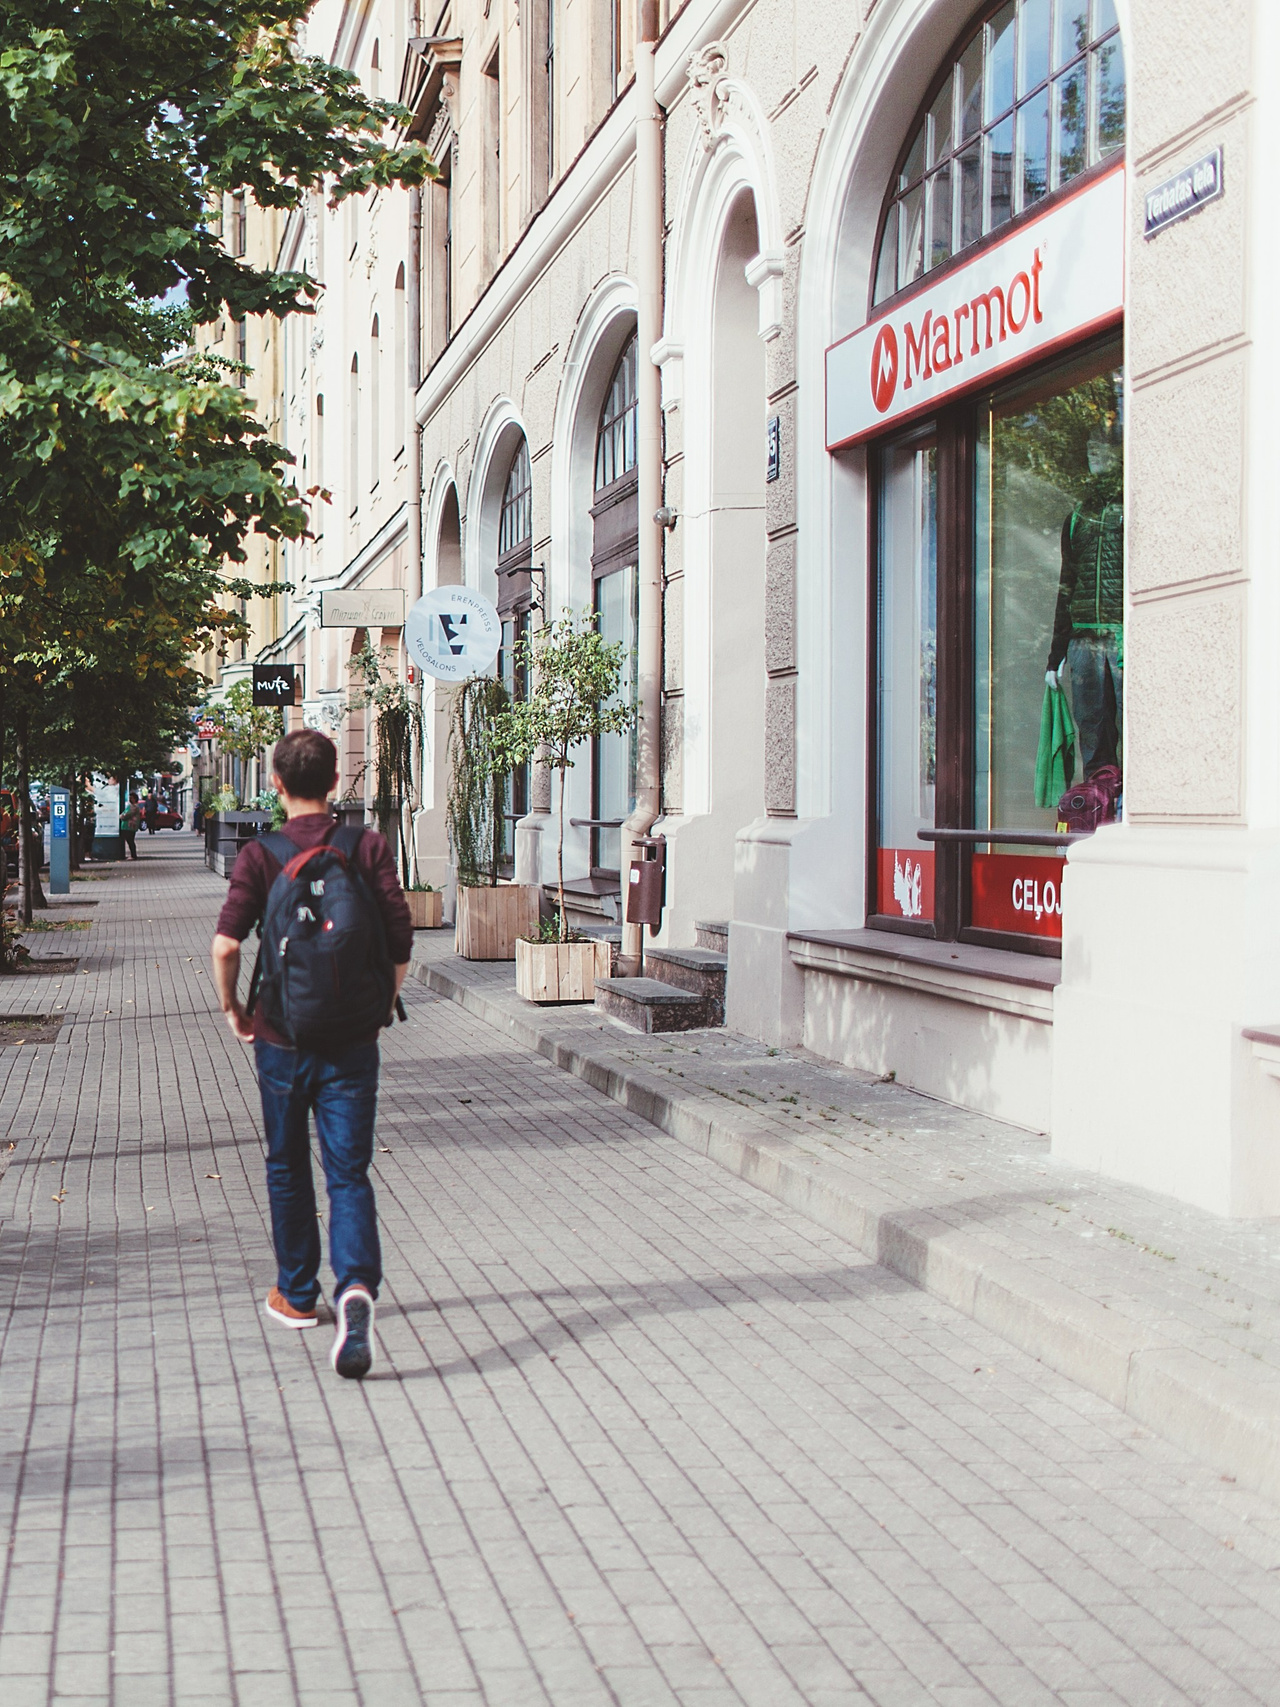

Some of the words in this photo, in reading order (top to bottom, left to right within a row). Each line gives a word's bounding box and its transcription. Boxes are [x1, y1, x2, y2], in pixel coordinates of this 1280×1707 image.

[1147, 178, 1192, 220] Tērbatas
[1194, 162, 1215, 193] iela
[903, 247, 1043, 390] Marmot
[451, 594, 492, 633] ERENPREISS
[416, 637, 457, 672] VELOSALONS
[56, 805, 63, 815] B
